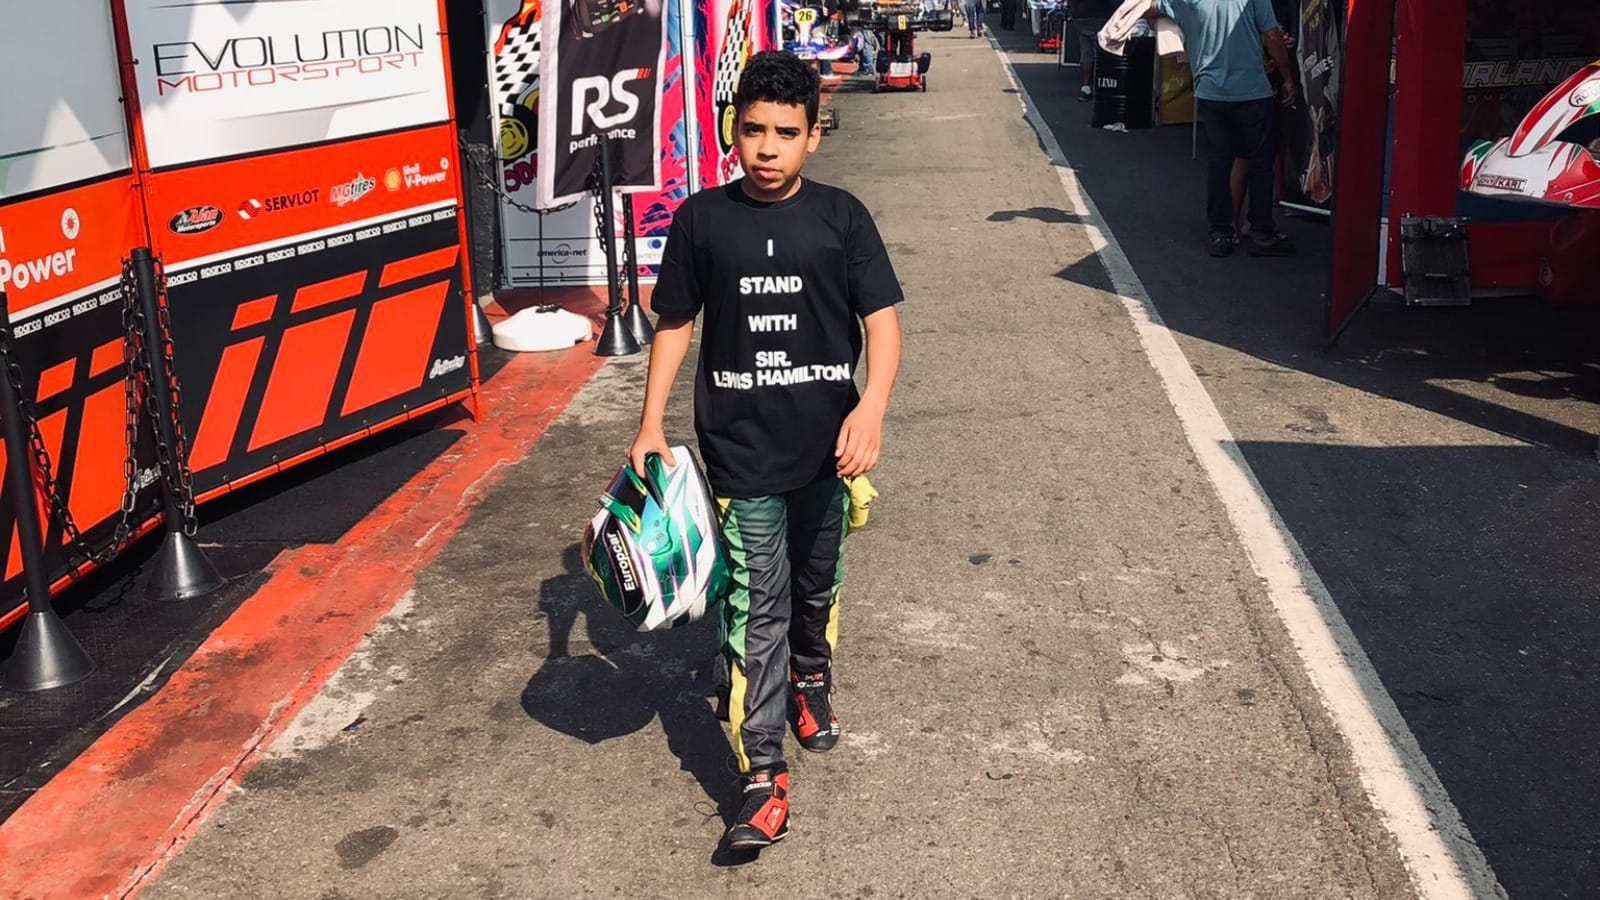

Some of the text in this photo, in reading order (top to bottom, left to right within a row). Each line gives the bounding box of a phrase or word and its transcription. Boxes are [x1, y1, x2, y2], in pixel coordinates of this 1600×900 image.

[798, 10, 813, 21] 26
[153, 23, 424, 77] EVOLUTION
[157, 51, 425, 96] MOTORSPORT
[571, 68, 641, 136] RS
[404, 171, 447, 188] V-Power
[265, 189, 319, 212] SERVLOT
[200, 263, 232, 279] sparco
[234, 255, 265, 271] sparco
[267, 247, 296, 262] sparco
[297, 240, 326, 255] sparco
[327, 233, 354, 248] sparco
[767, 239, 774, 257] I
[739, 276, 803, 294] STAND
[13, 319, 42, 339] sparco
[44, 308, 71, 327] sparco
[72, 298, 98, 316] sparco
[748, 314, 797, 332] WITH
[755, 351, 792, 367] SIR.
[756, 363, 851, 387] HAMILTON
[607, 533, 636, 591] Europcar
